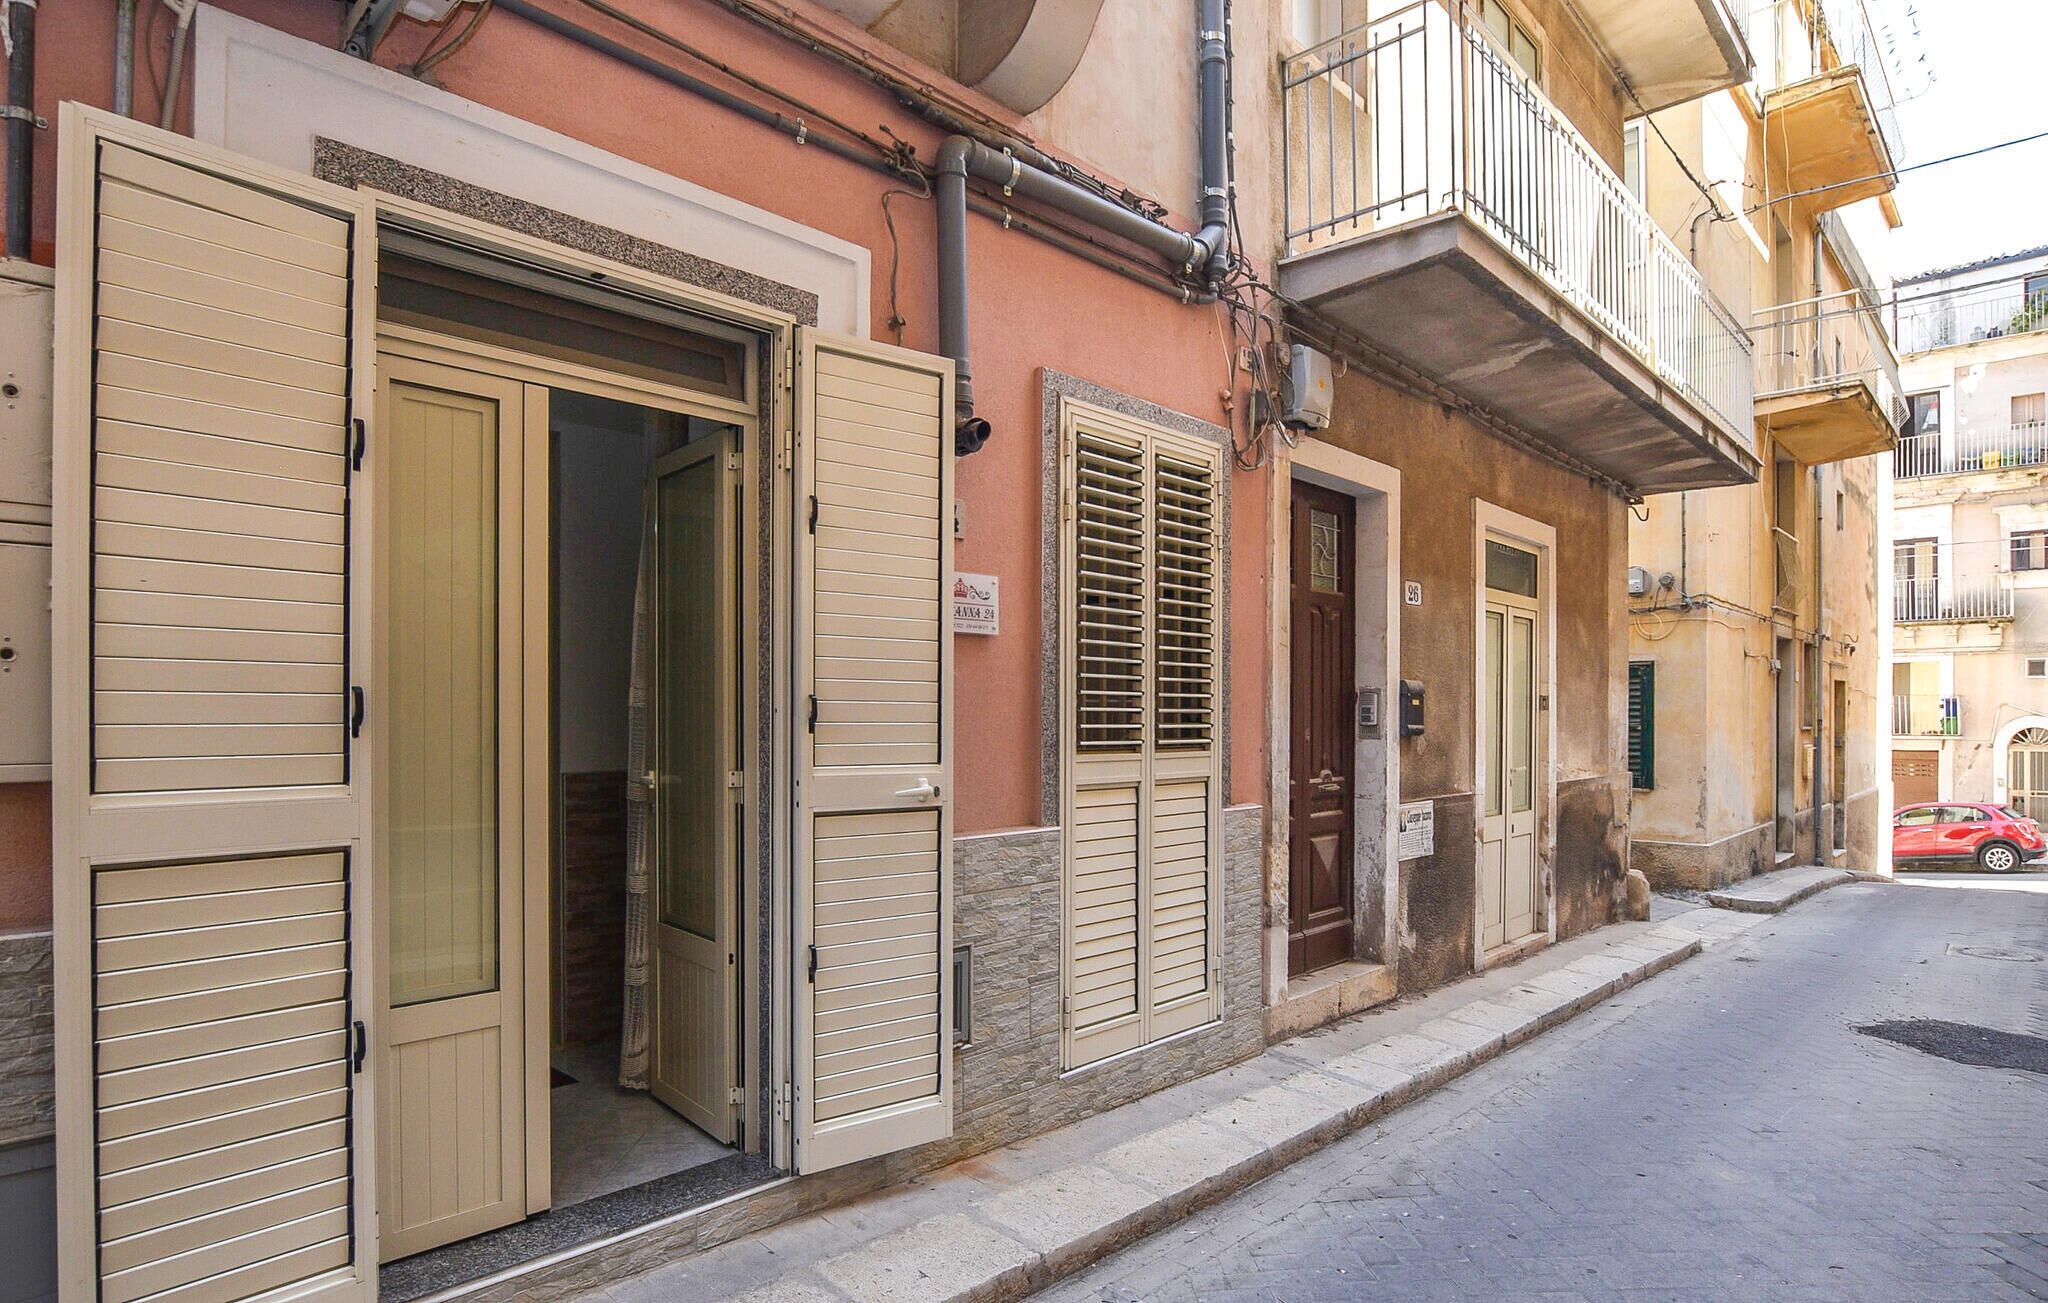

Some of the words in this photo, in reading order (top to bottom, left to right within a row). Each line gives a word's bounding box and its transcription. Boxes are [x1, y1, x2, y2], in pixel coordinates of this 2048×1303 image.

[1408, 584, 1419, 602] 26
[954, 605, 981, 619] ANNA
[983, 607, 995, 620] 24
